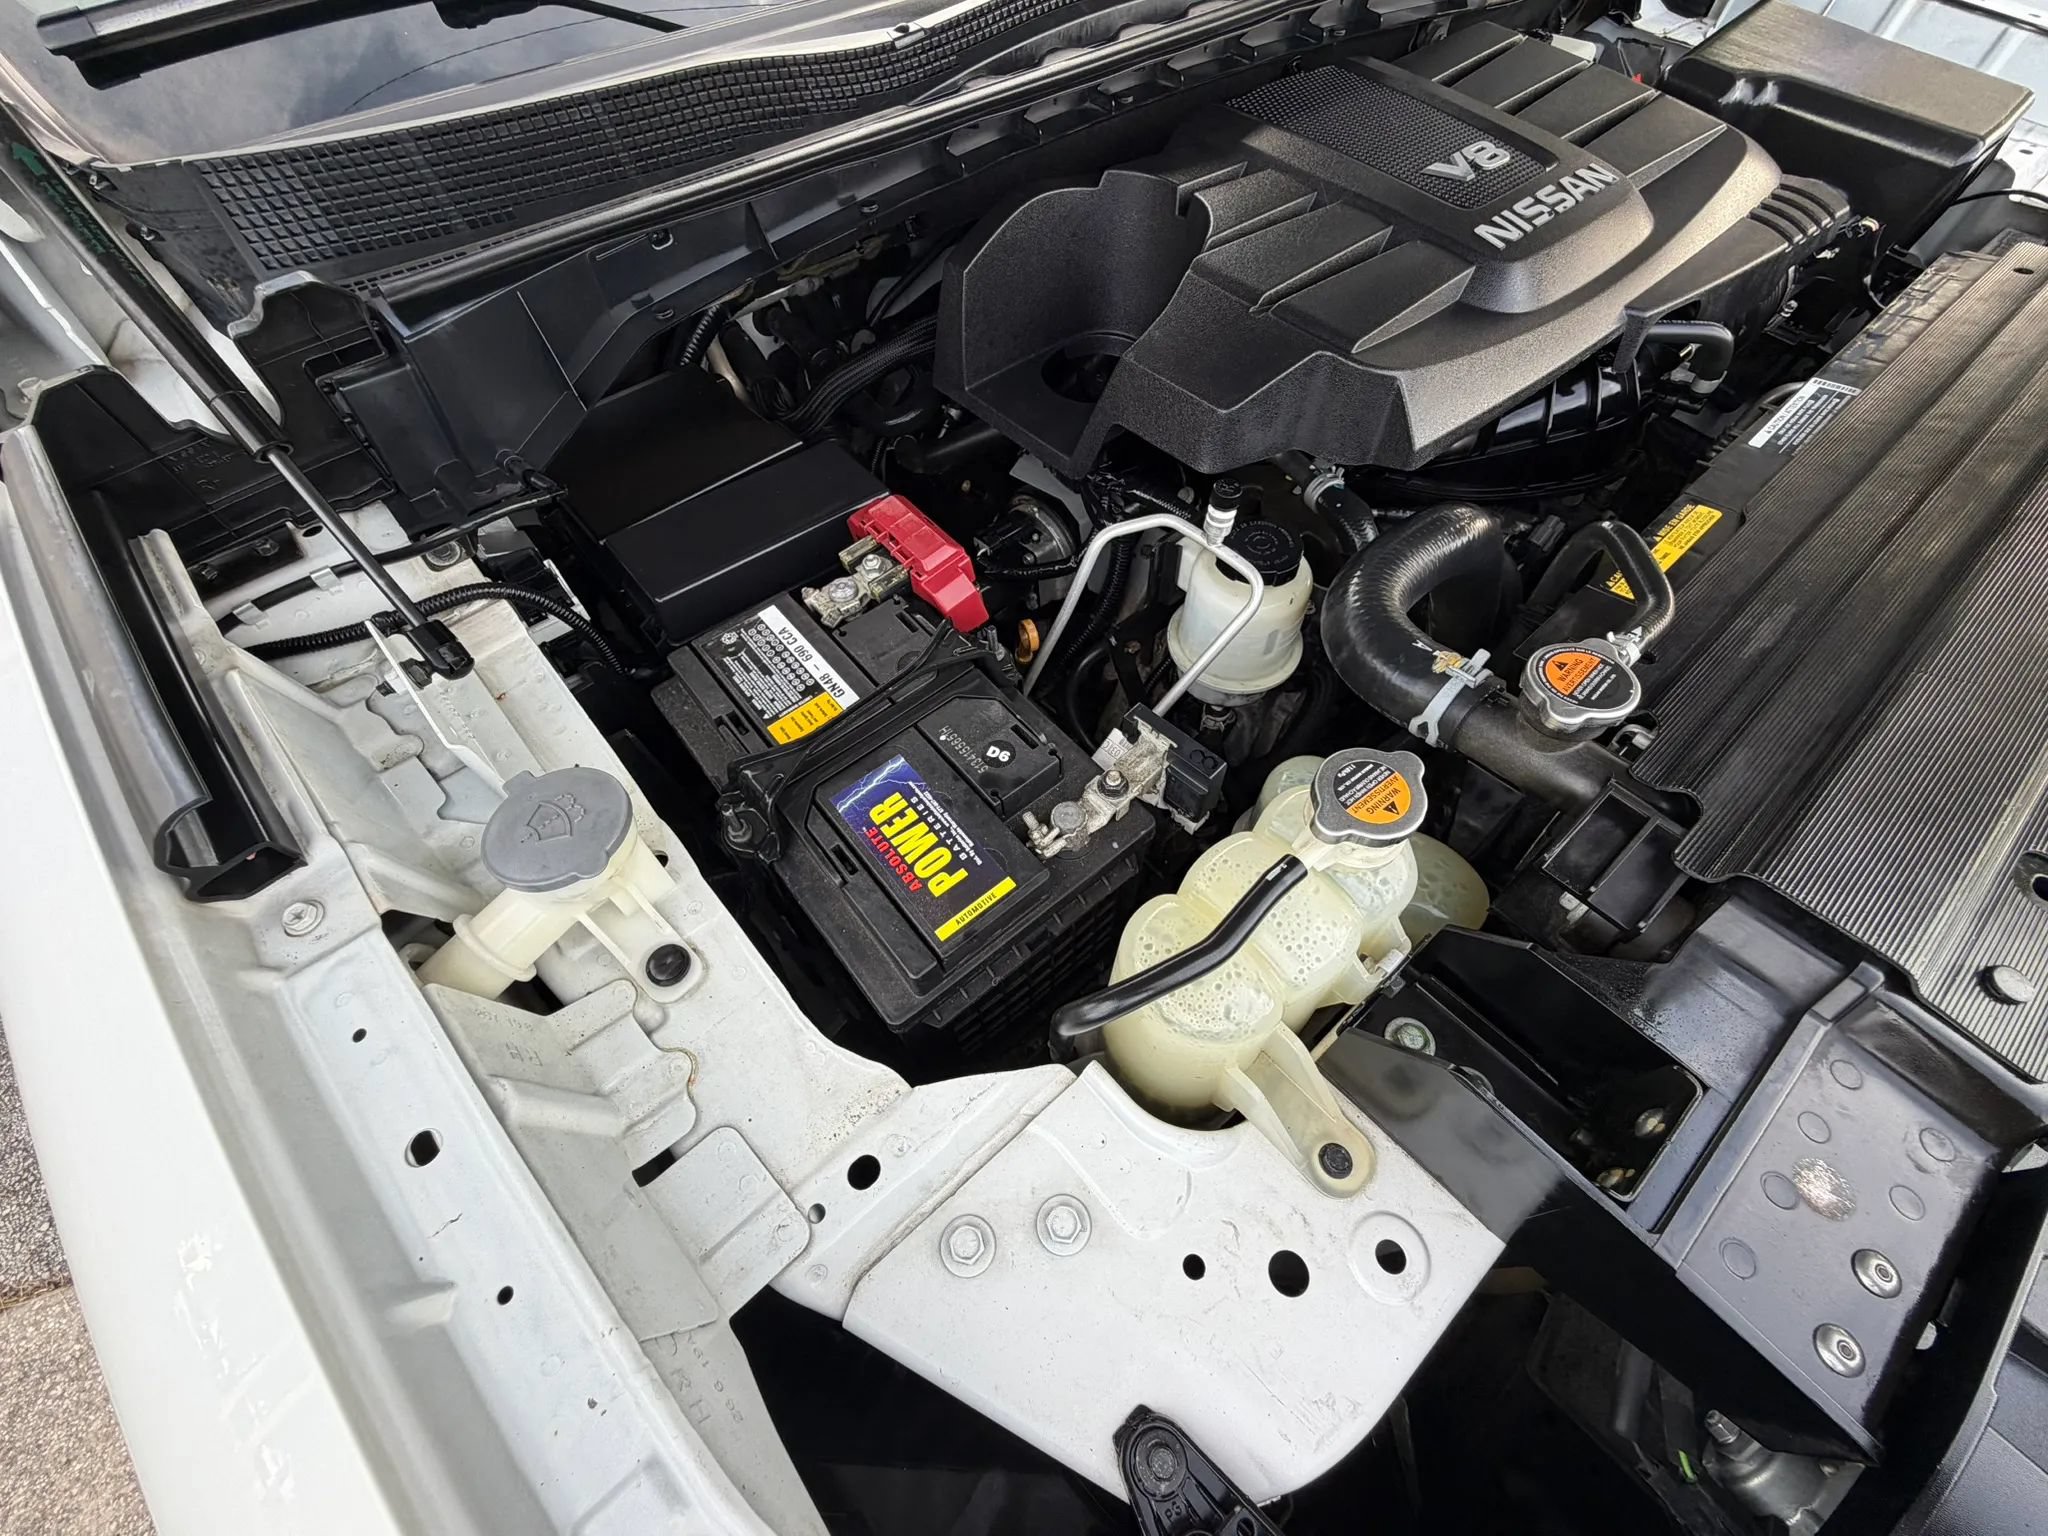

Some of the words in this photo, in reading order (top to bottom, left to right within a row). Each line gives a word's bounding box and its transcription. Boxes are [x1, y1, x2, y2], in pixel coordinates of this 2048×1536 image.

[1420, 140, 1510, 182] V8
[1474, 162, 1619, 250] NISSAN
[1668, 517, 1679, 526] EN
[777, 626, 797, 646] CCA
[793, 644, 813, 663] 690
[818, 671, 845, 699] GN48
[1557, 656, 1583, 682] WARNING
[1562, 657, 1596, 692] AVERTISSEMENT
[986, 746, 1011, 762] D6
[1350, 775, 1399, 813] AVERTISSEMENT
[1365, 787, 1400, 815] WARNING
[866, 790, 969, 898] POWER
[909, 795, 968, 860] BATTERIES
[864, 825, 923, 892] ABSOLUTE
[955, 891, 998, 926] AUTOMOTIVE
